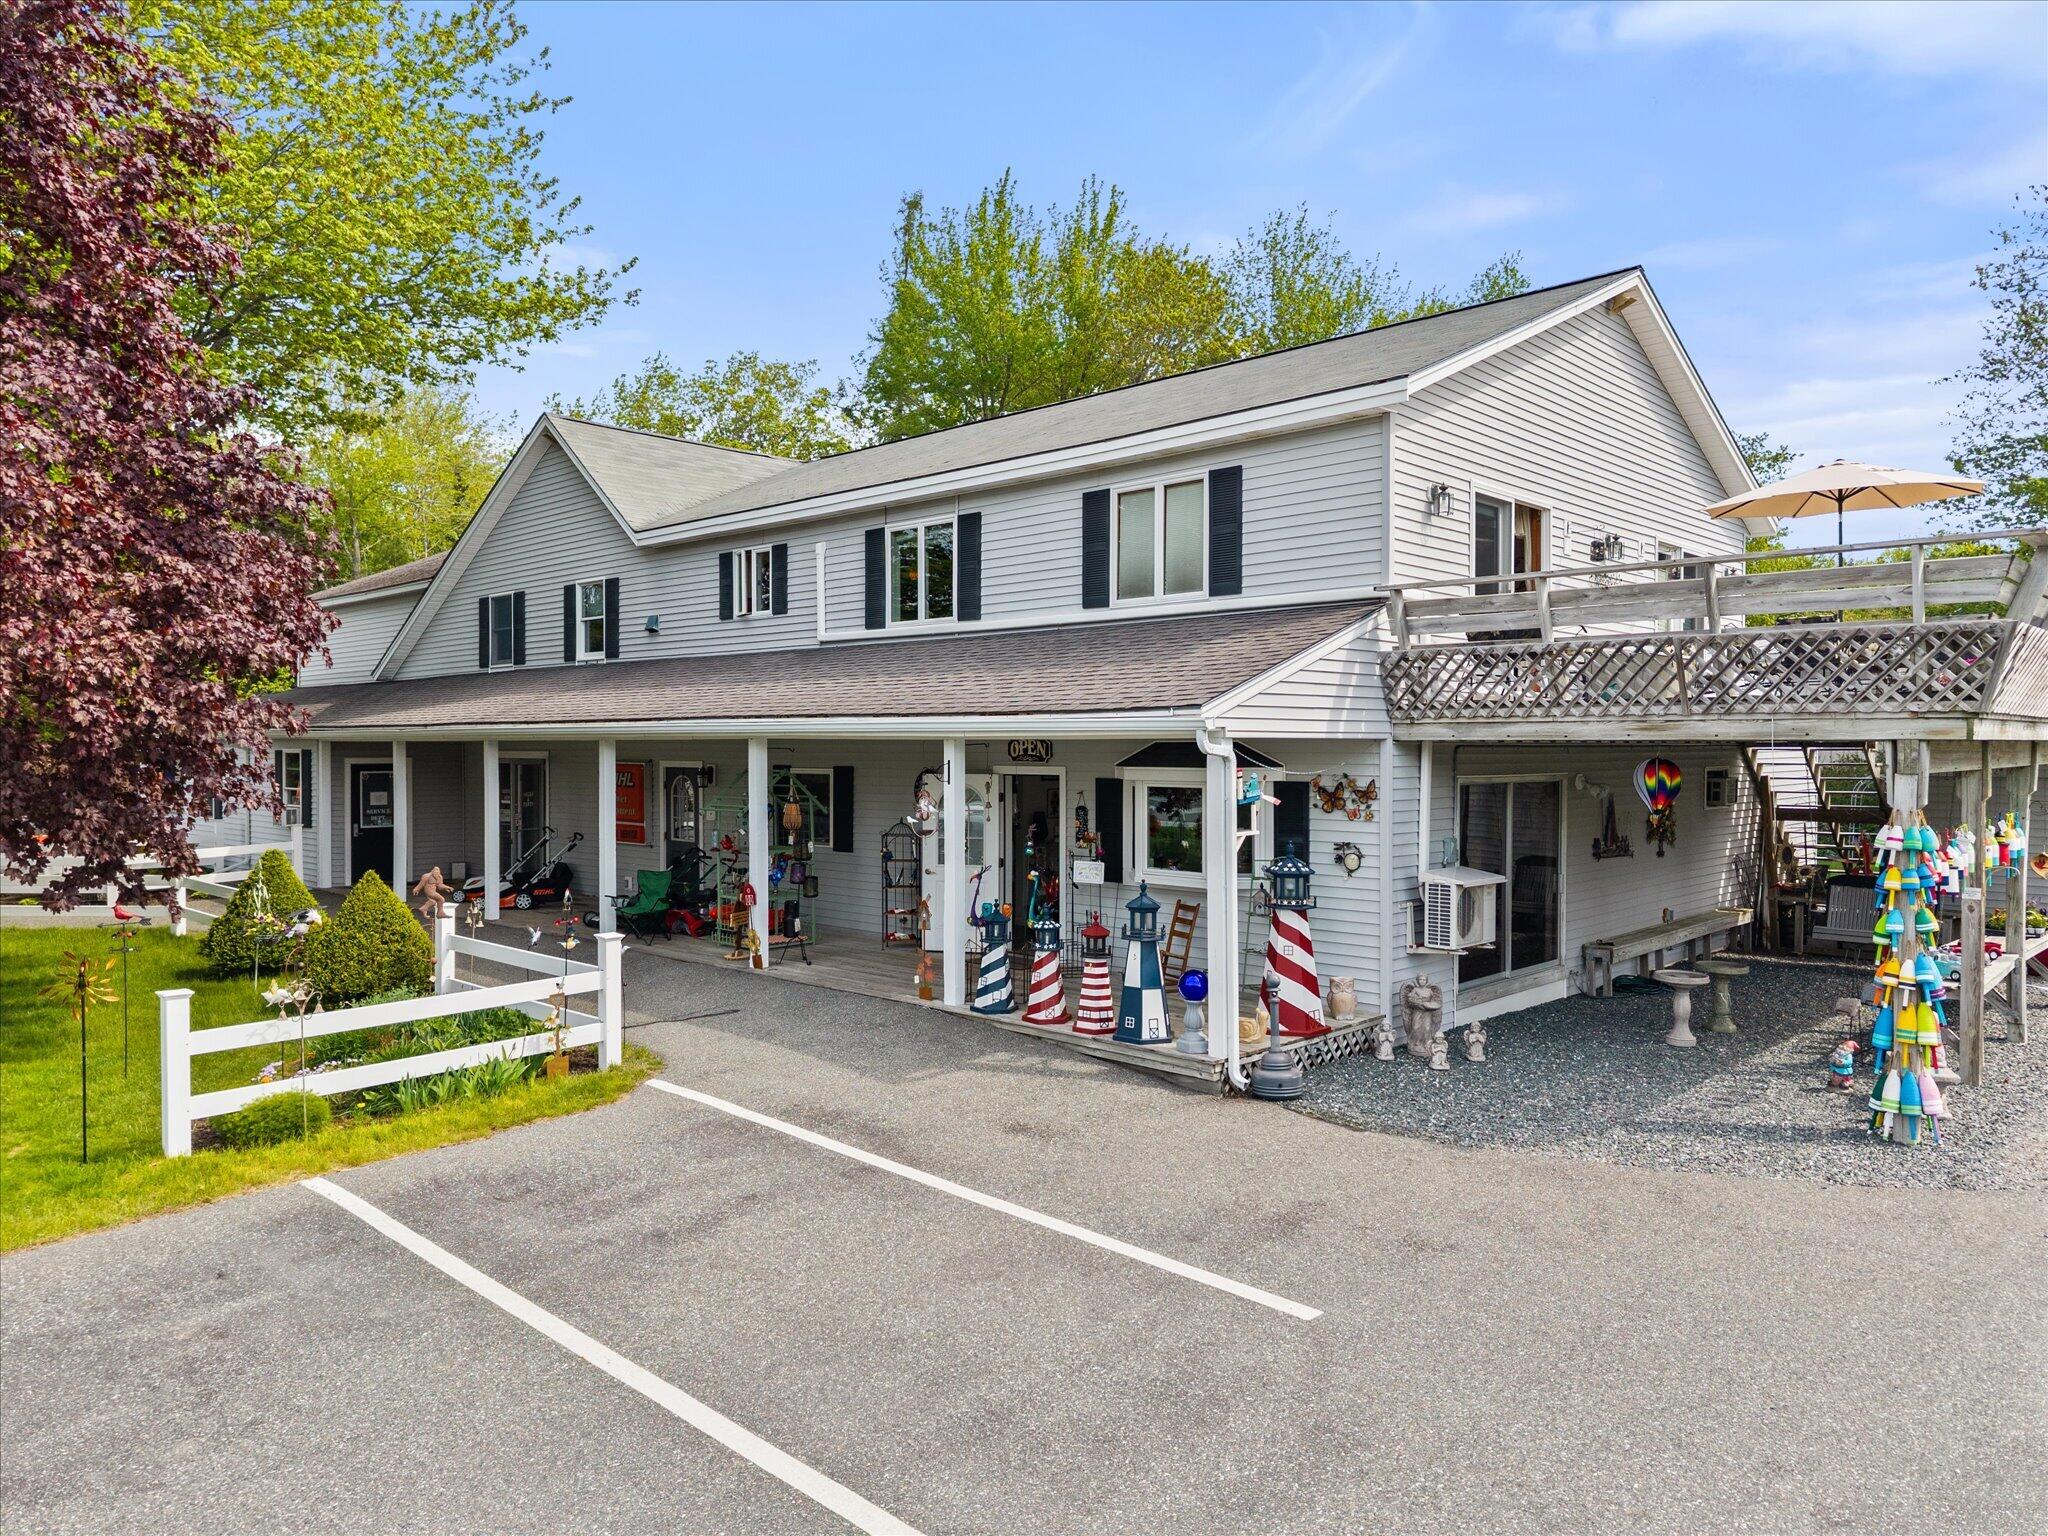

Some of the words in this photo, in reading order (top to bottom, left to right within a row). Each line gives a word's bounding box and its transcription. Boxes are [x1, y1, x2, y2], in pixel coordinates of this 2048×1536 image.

[1010, 740, 1046, 758] OPEN
[616, 772, 634, 787] IHL
[533, 888, 555, 896] STIHL
